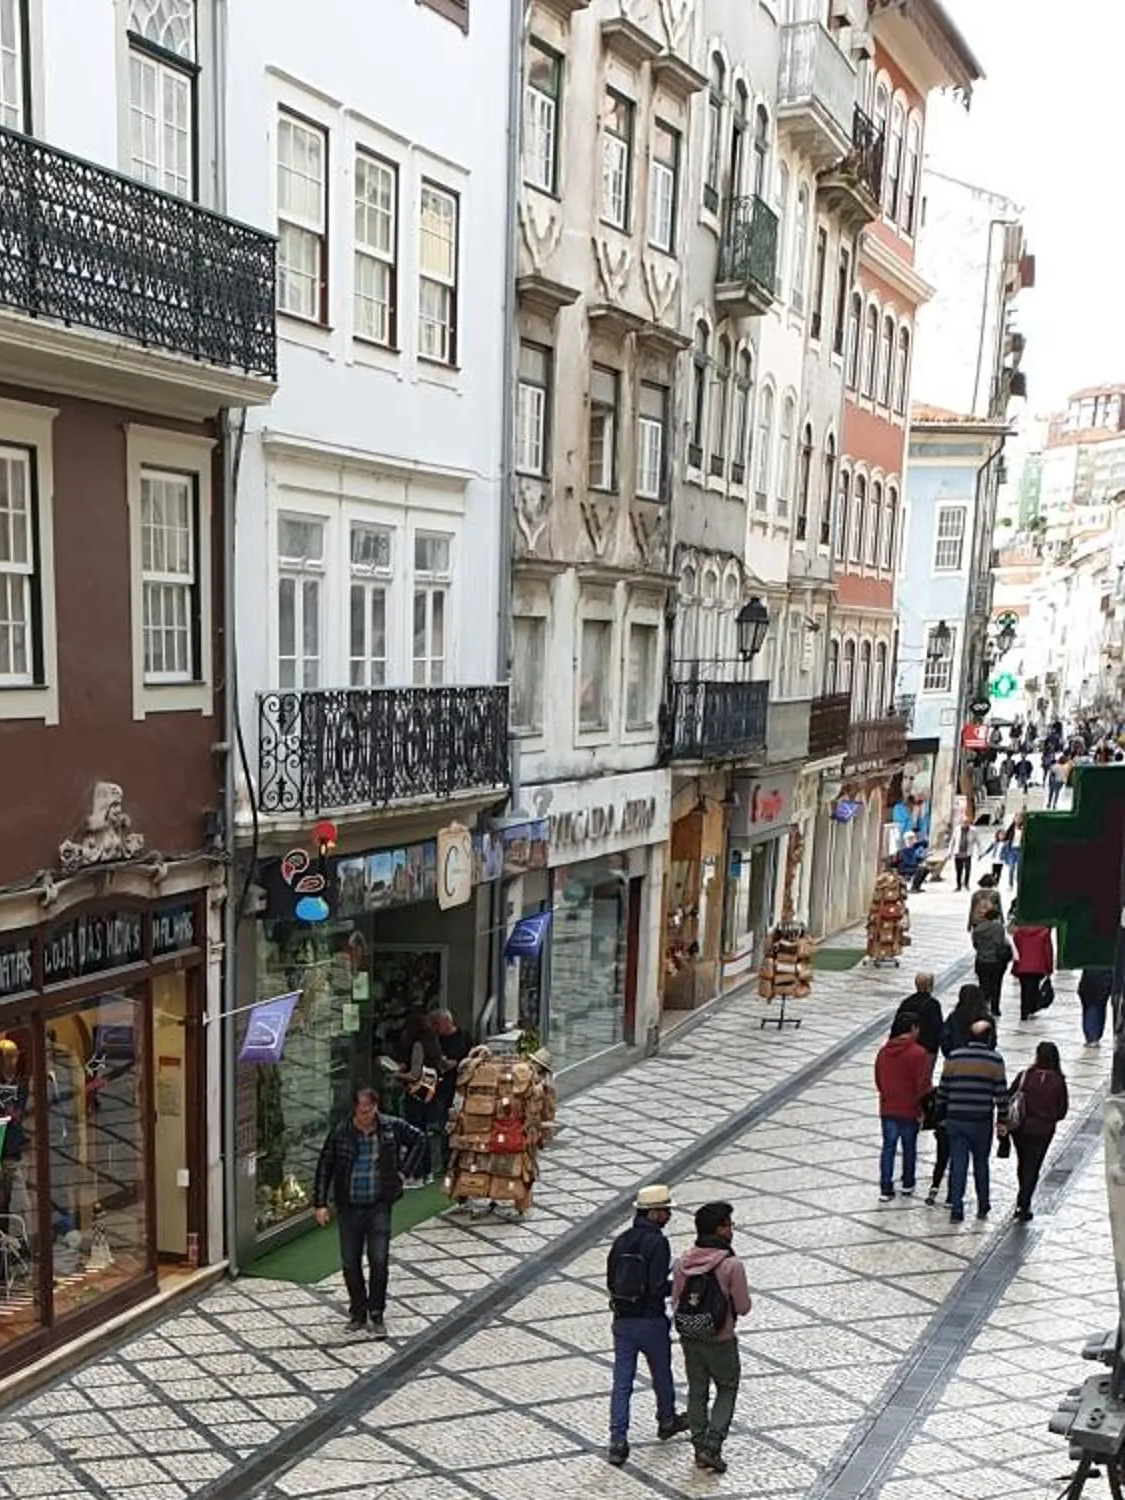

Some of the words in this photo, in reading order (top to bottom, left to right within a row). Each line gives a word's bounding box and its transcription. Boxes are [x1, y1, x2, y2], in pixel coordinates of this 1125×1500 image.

[44, 932, 74, 973] LOJA
[78, 922, 102, 966] DAS
[106, 918, 141, 956] MEIAS
